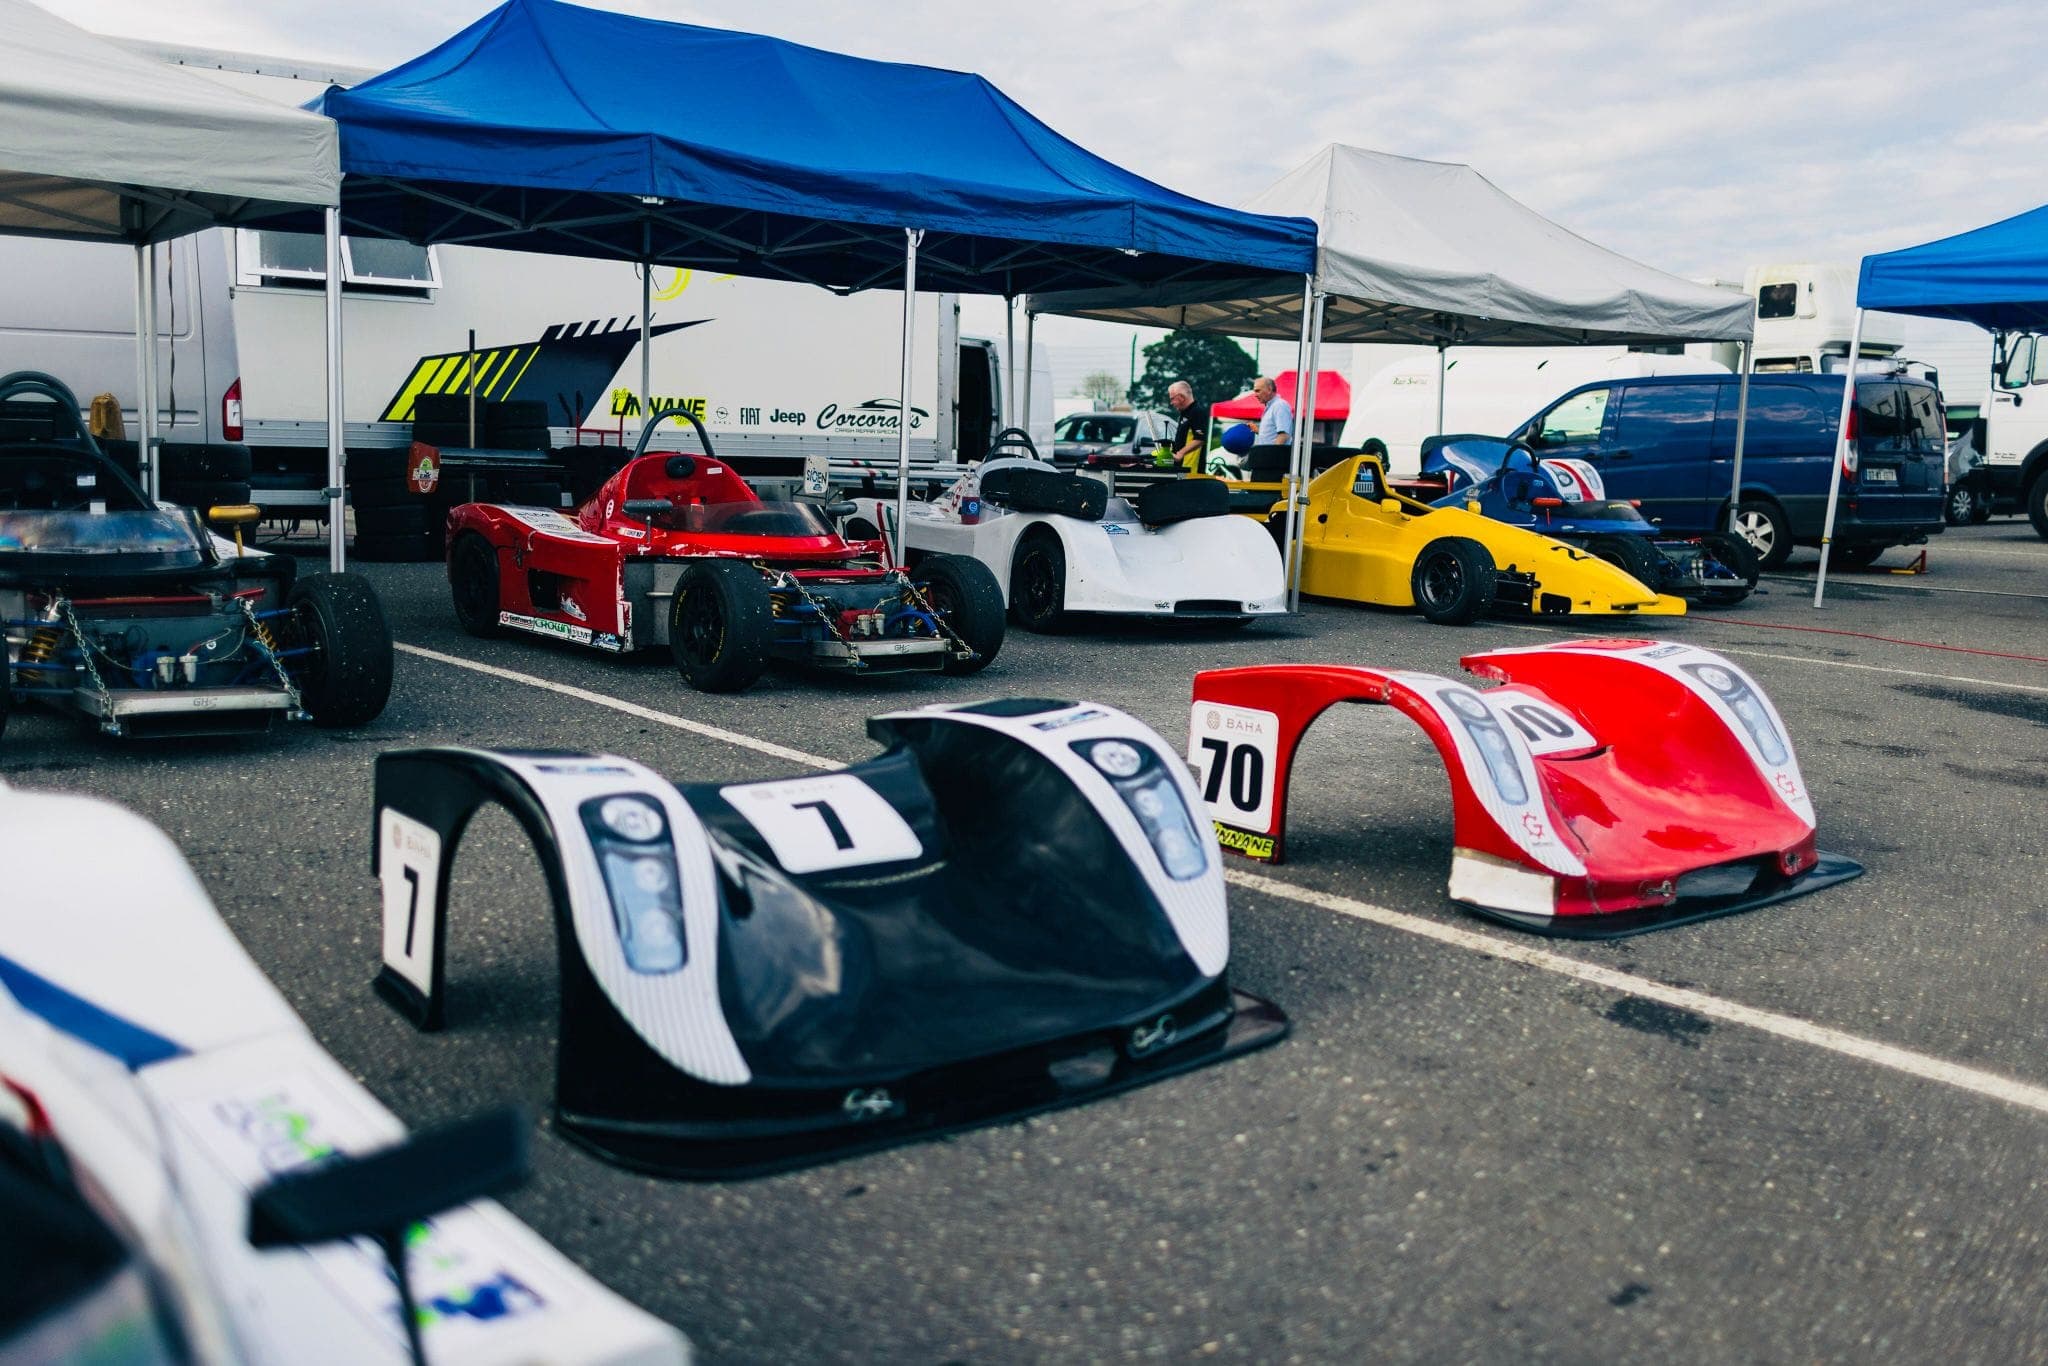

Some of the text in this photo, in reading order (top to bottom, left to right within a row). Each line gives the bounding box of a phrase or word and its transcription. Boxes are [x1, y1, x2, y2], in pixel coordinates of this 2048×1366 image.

[740, 407, 761, 426] FIAT
[769, 408, 806, 426] Jeep
[816, 403, 922, 430] Corcora's
[1226, 717, 1264, 735] BAHA
[1201, 736, 1265, 813] 70
[791, 799, 856, 852] 7
[403, 863, 420, 959] 7
